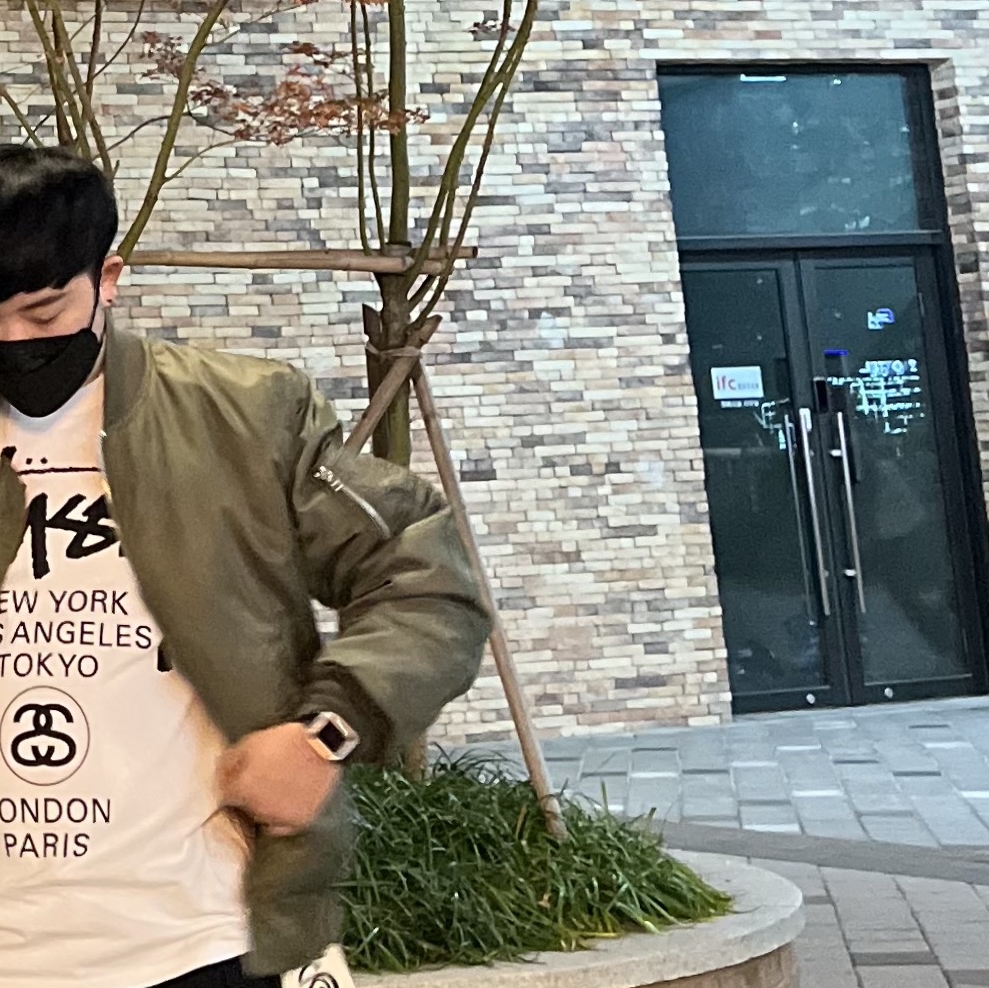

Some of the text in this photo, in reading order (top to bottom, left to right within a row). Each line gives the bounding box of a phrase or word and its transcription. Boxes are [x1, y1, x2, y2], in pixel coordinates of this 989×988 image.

[48, 589, 129, 616] YORK
[10, 620, 152, 650] ANGELES
[3, 832, 90, 858] PARIS
